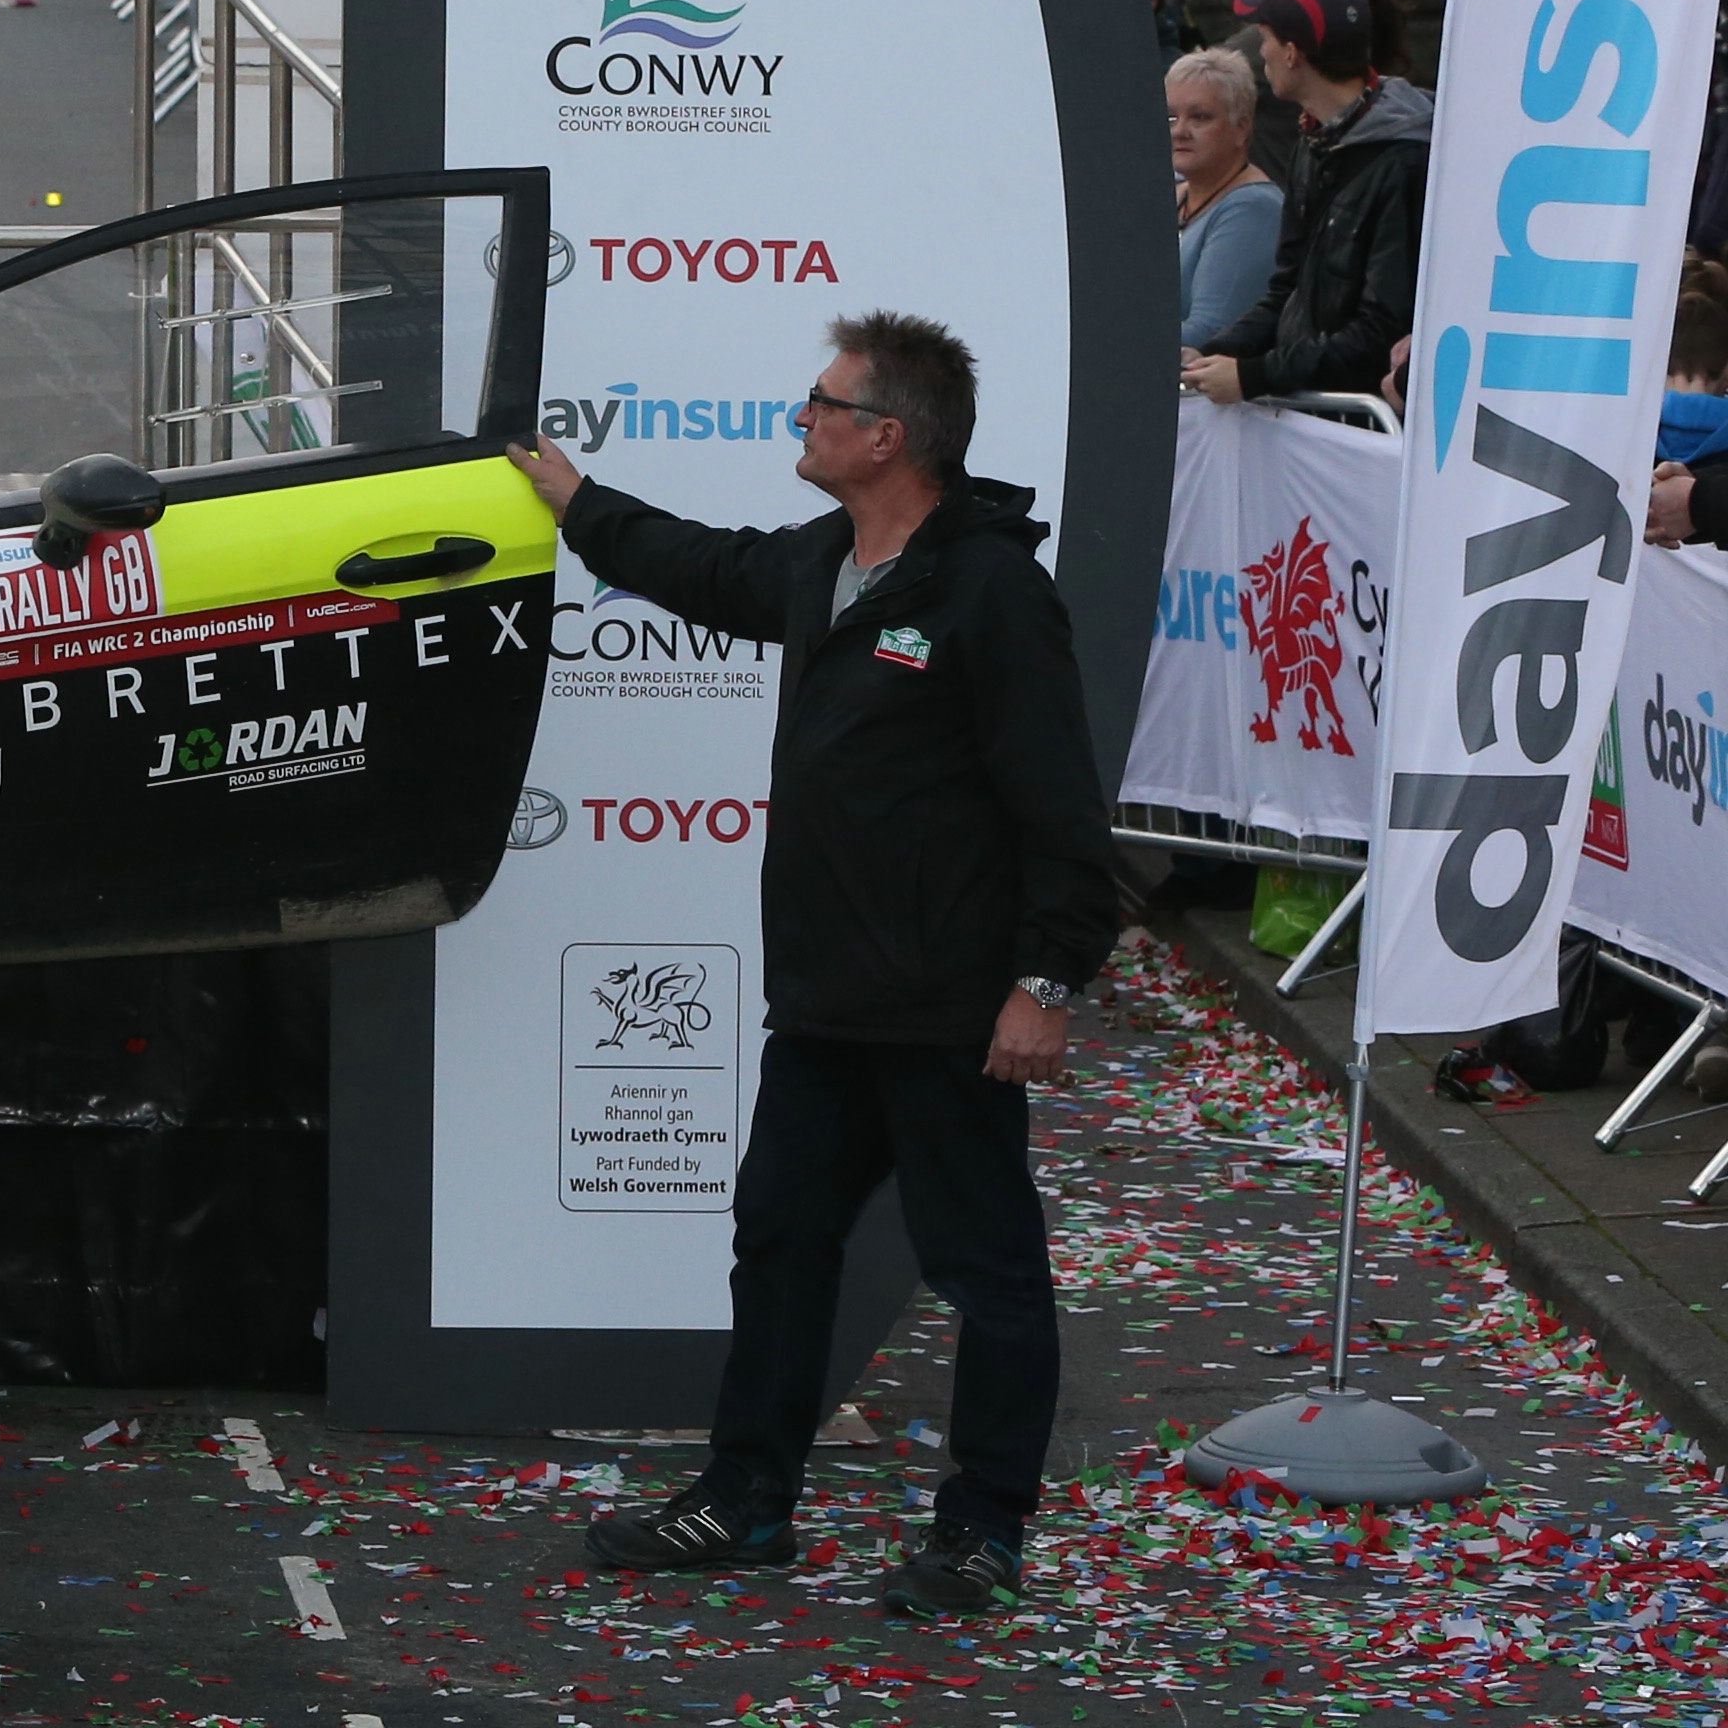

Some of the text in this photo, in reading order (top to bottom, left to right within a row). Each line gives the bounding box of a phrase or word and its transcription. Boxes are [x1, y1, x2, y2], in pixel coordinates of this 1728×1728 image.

[546, 36, 784, 97] CONWY
[559, 105, 772, 119] CYNGOR BWRDEISTREF SIROL
[559, 120, 771, 134] COUNTY BOROUGH COUNCIL
[589, 237, 839, 283] TOYOTA
[102, 533, 150, 615] GB
[53, 611, 275, 660] FIA WRC Championship
[22, 601, 528, 732] BRETTEX
[551, 671, 765, 685] CYNGOR BWRDEISTREF SIROL
[551, 685, 765, 699] COUNTY BOROUGH COUNCIL
[228, 753, 366, 787] ROAD SURFACING LTD
[581, 798, 770, 844] TOYO
[610, 1084, 688, 1102] Ariennir yn
[604, 1106, 694, 1126] Rhannol gan
[571, 1127, 727, 1147] Lywodraeth Cymru
[596, 1156, 701, 1175] Part Funded by
[570, 1178, 727, 1195] Welsh Government
